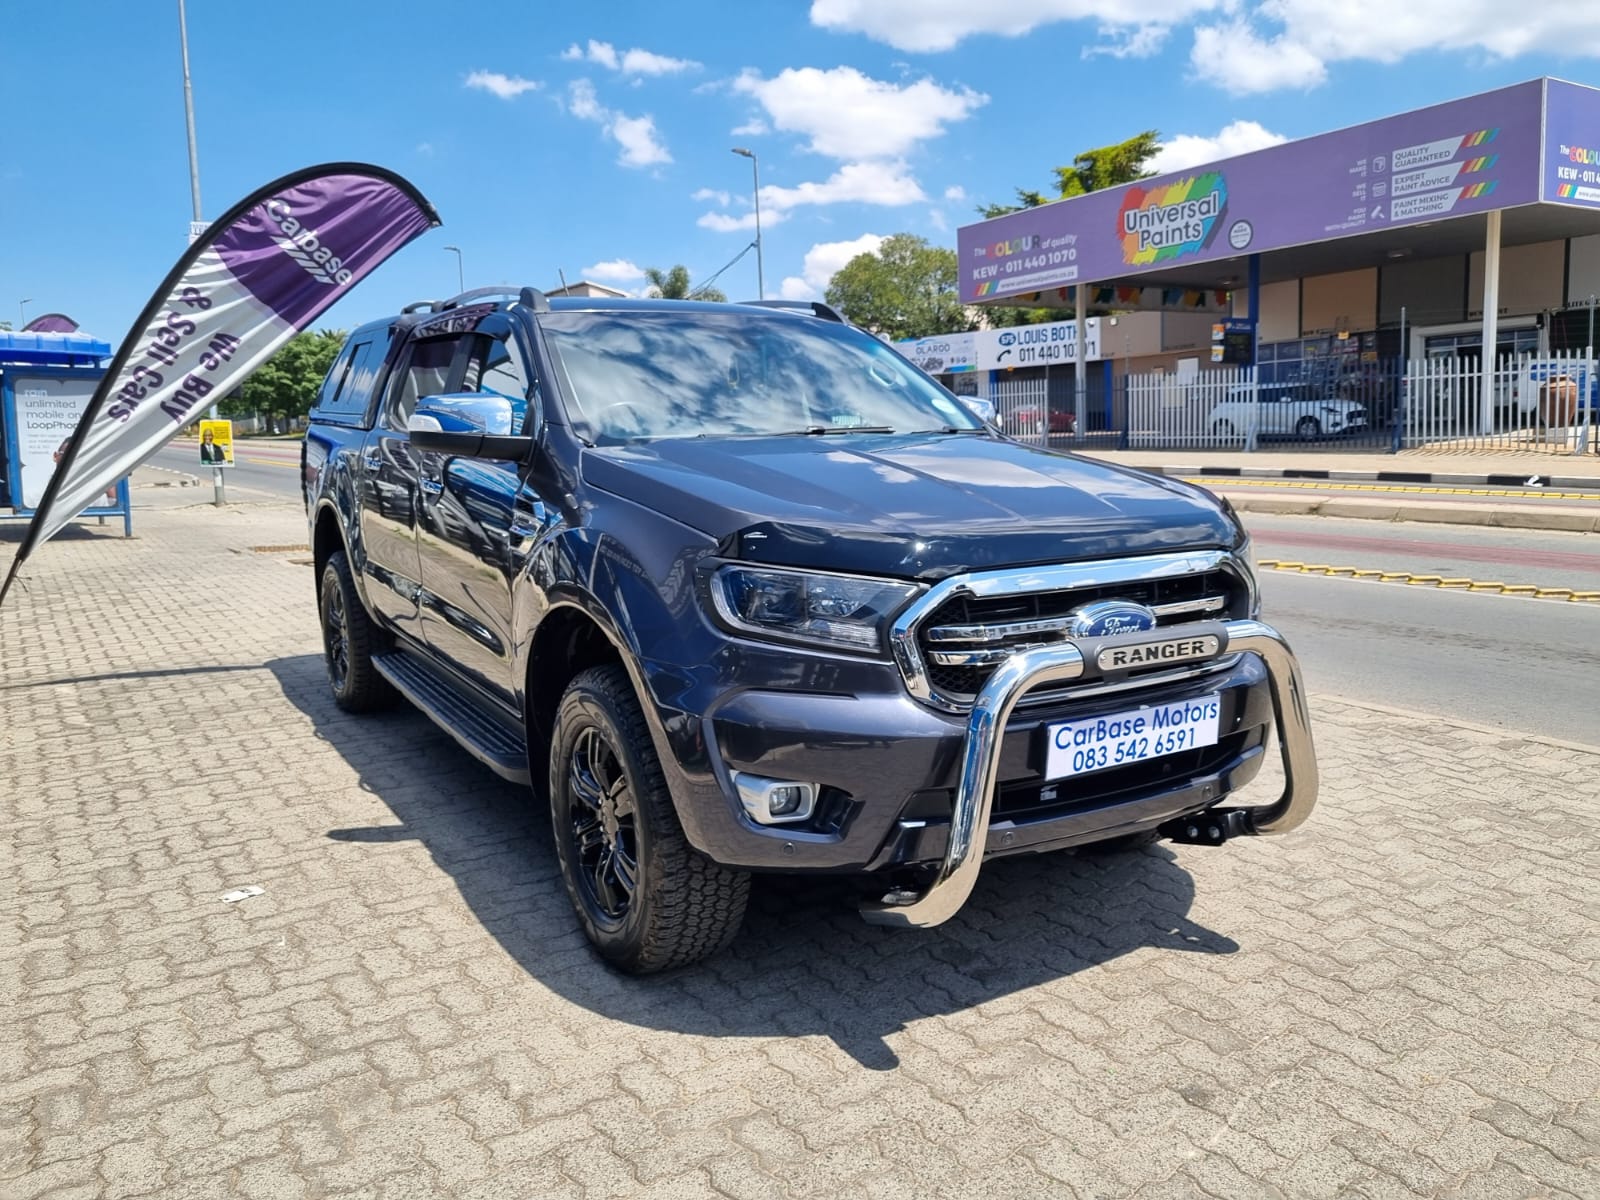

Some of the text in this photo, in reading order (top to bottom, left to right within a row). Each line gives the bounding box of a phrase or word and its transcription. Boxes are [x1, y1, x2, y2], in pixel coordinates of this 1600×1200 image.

[1394, 146, 1429, 160] QUALITY
[1560, 144, 1570, 155] The
[1394, 150, 1451, 168] GUARANTEED
[1394, 173, 1425, 185] EXPERT
[1558, 166, 1578, 180] KEW
[1583, 170, 1595, 183] 011
[1394, 176, 1450, 192] PAINT ADVICE
[1394, 193, 1449, 209] PAINT MIXING
[1400, 202, 1443, 216] MATCHING
[1125, 192, 1218, 231] Universal
[1140, 222, 1201, 249] Paints
[974, 234, 1077, 259] The COLOUR of quality
[973, 264, 998, 280] KEW
[1005, 260, 1022, 273] 011
[1024, 254, 1046, 270] 440
[1048, 248, 1077, 263] 1070
[1017, 328, 1048, 345] LOUIS
[1051, 325, 1088, 342] BOTH
[107, 286, 212, 423] & Sell Cars
[1019, 347, 1035, 361] 011
[1038, 345, 1060, 360] 440
[160, 332, 241, 424] We Buy
[25, 399, 76, 408] unlimited
[26, 410, 65, 419] mobile
[1113, 640, 1205, 666] RANGER
[1055, 702, 1217, 750] CarBase Motors
[1073, 727, 1195, 772] 083 542 6591
